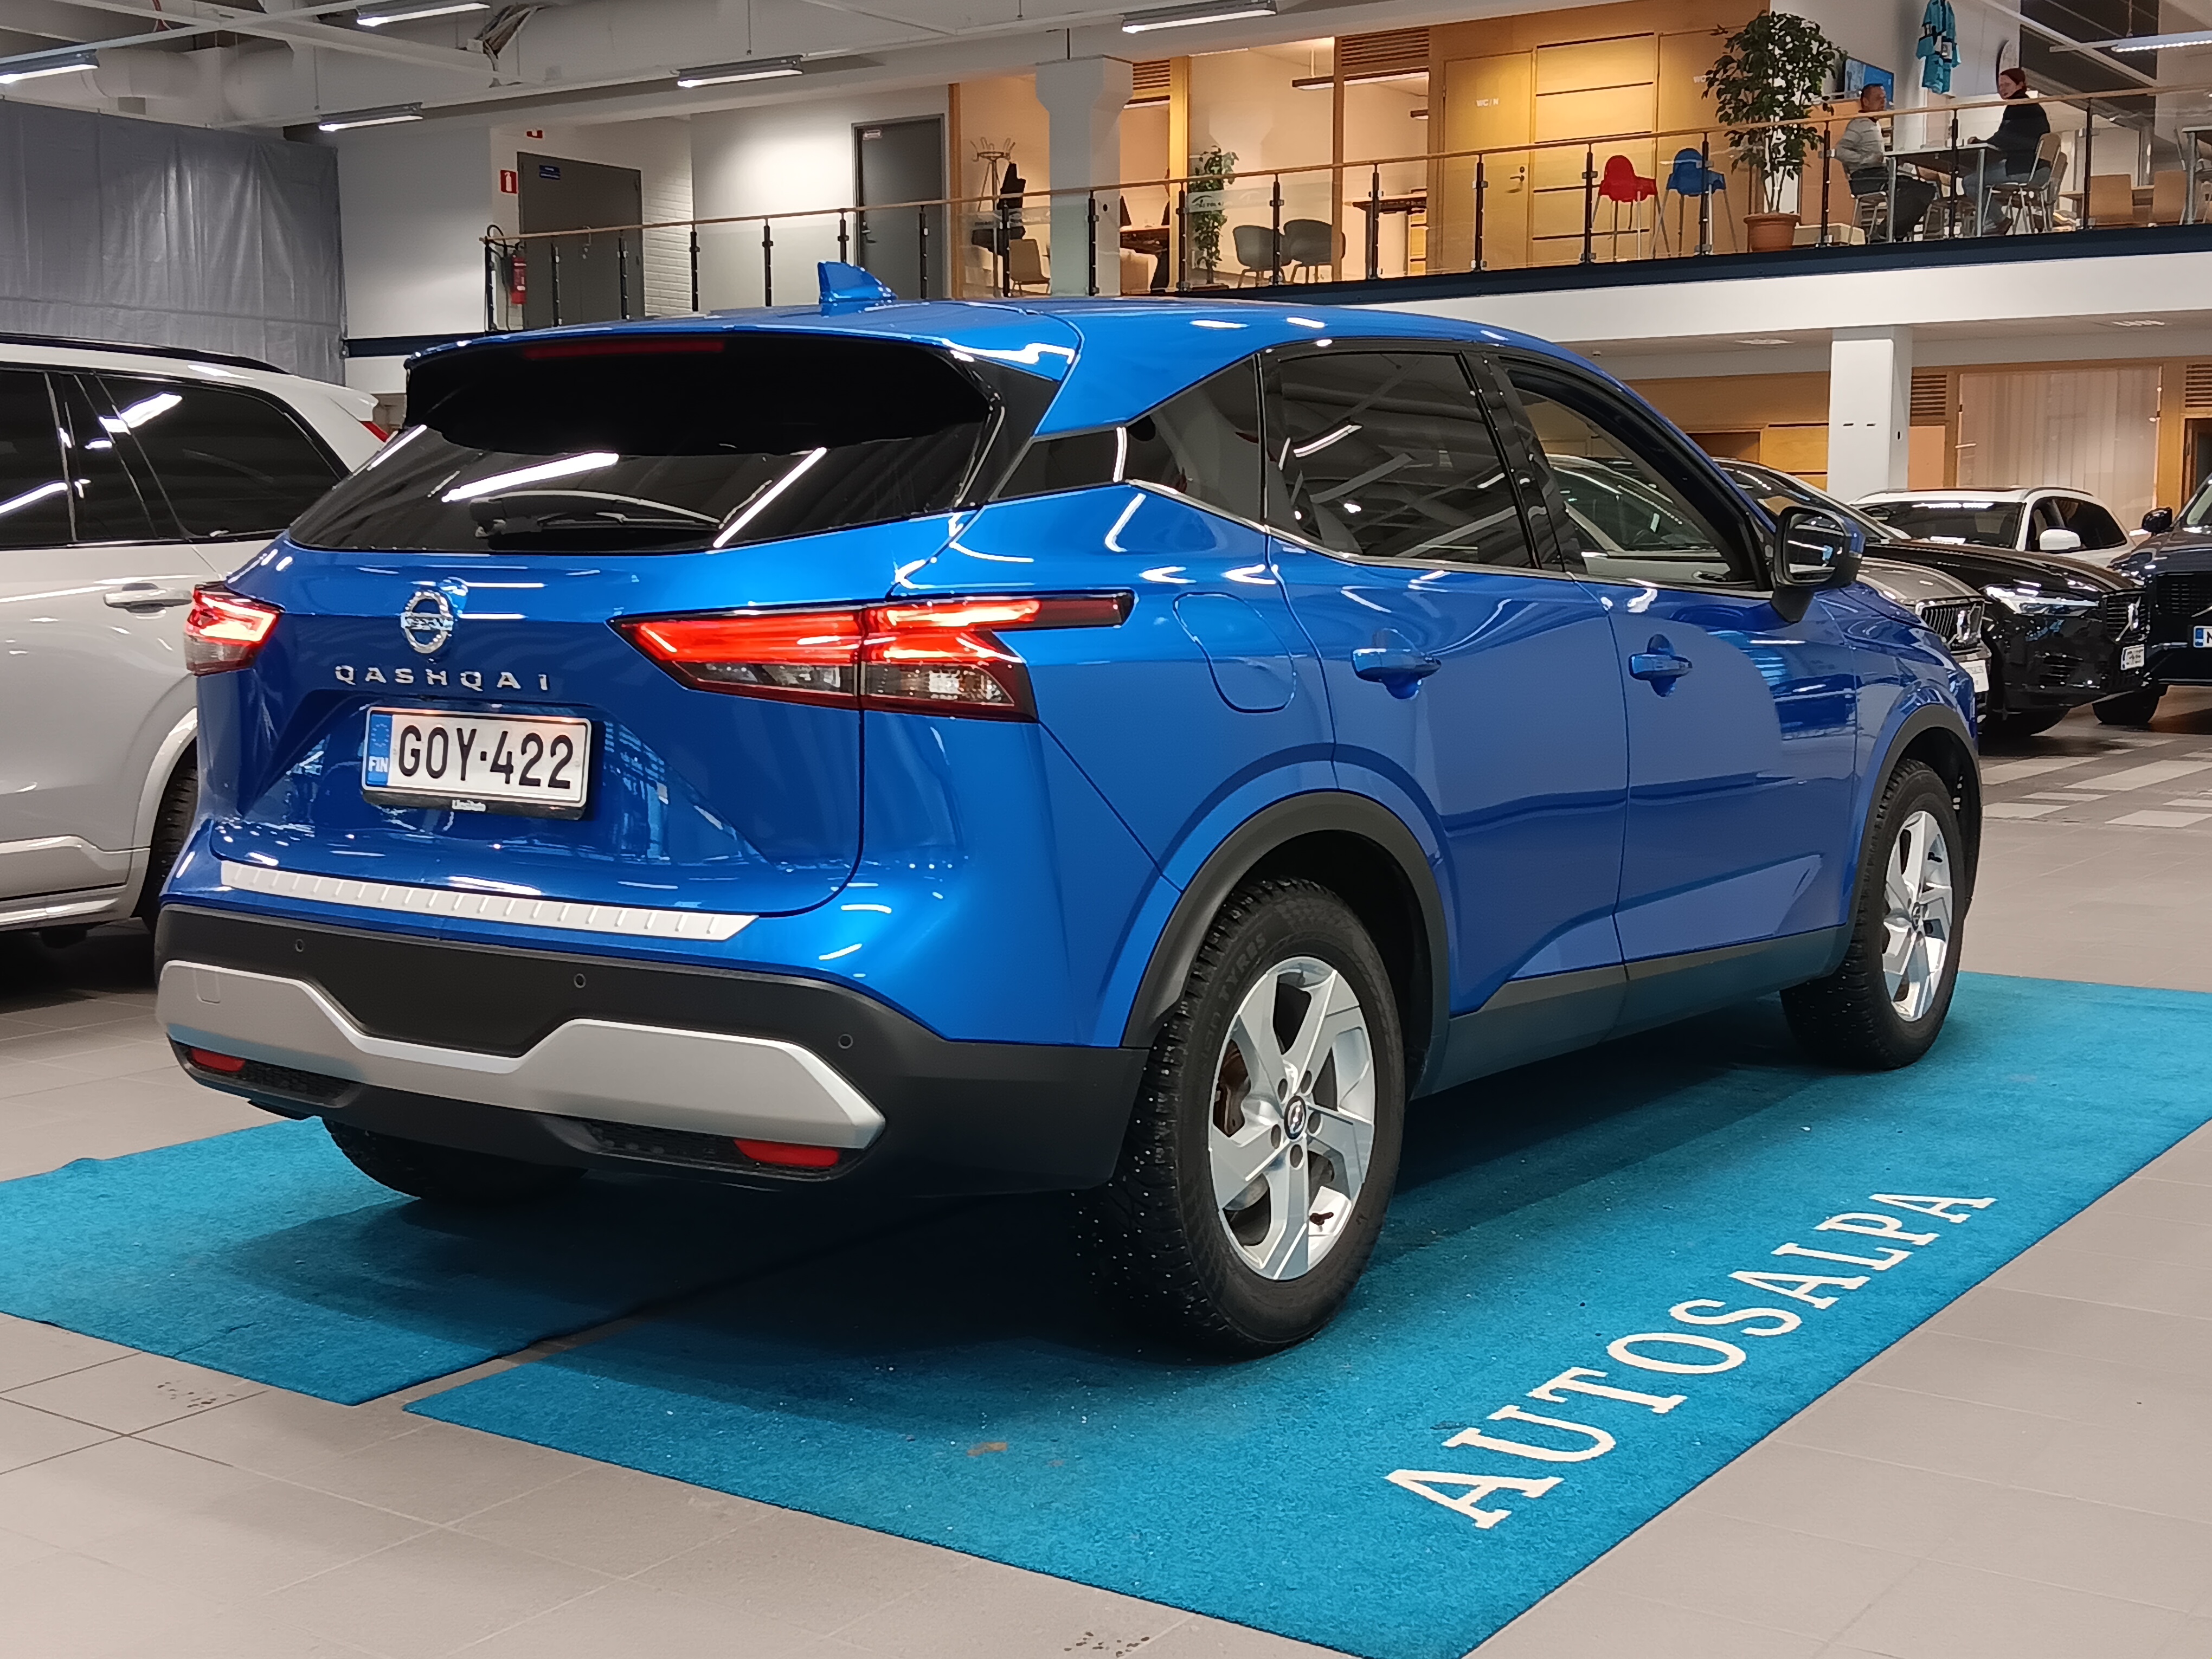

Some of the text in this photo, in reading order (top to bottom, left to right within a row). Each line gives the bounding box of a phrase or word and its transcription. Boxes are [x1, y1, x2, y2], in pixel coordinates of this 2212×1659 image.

[335, 665, 549, 691] QASHQAI
[368, 757, 389, 773] FIN
[1383, 1193, 1998, 1530] AUTOSALPA
